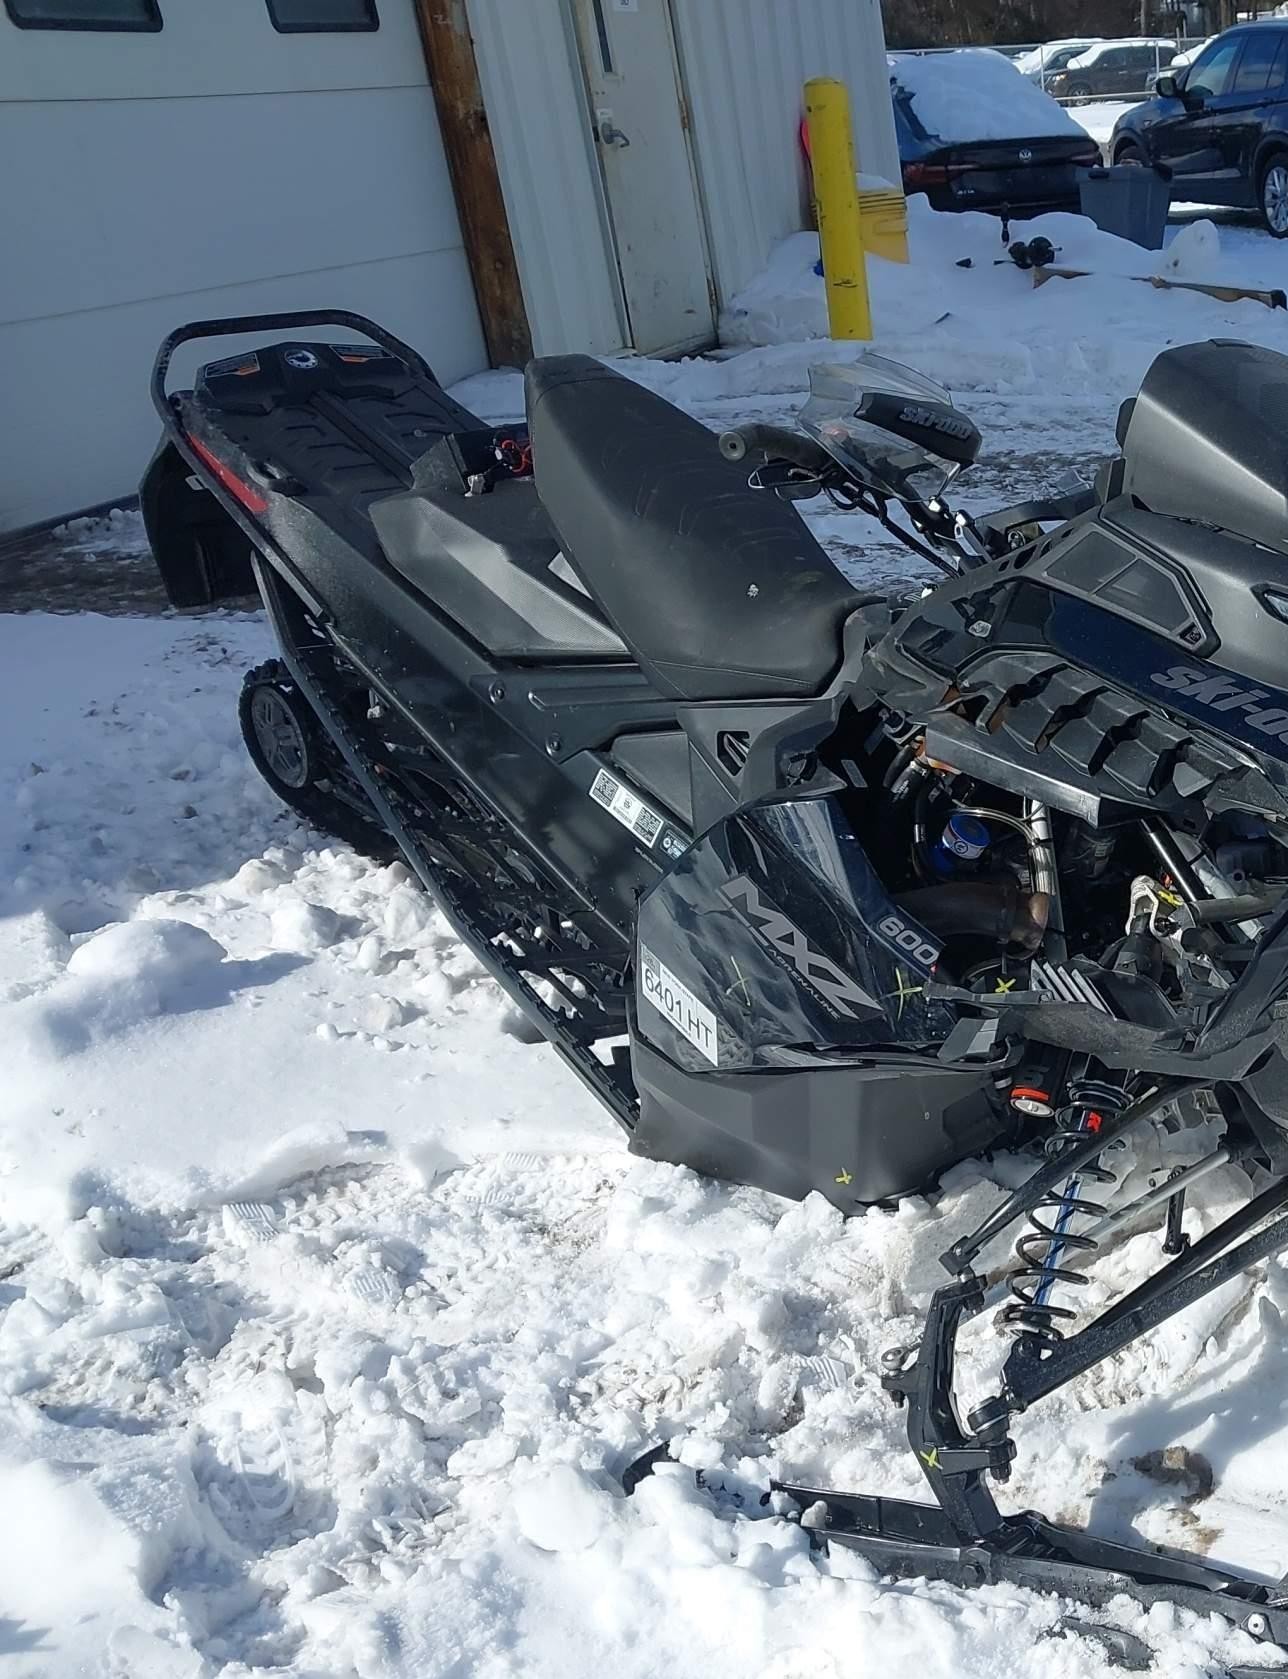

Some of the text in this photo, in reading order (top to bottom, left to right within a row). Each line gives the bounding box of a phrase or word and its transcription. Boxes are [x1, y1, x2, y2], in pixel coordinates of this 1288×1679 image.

[879, 916, 940, 965] 600
[645, 967, 682, 1021] 6401
[688, 1009, 712, 1048] HT
